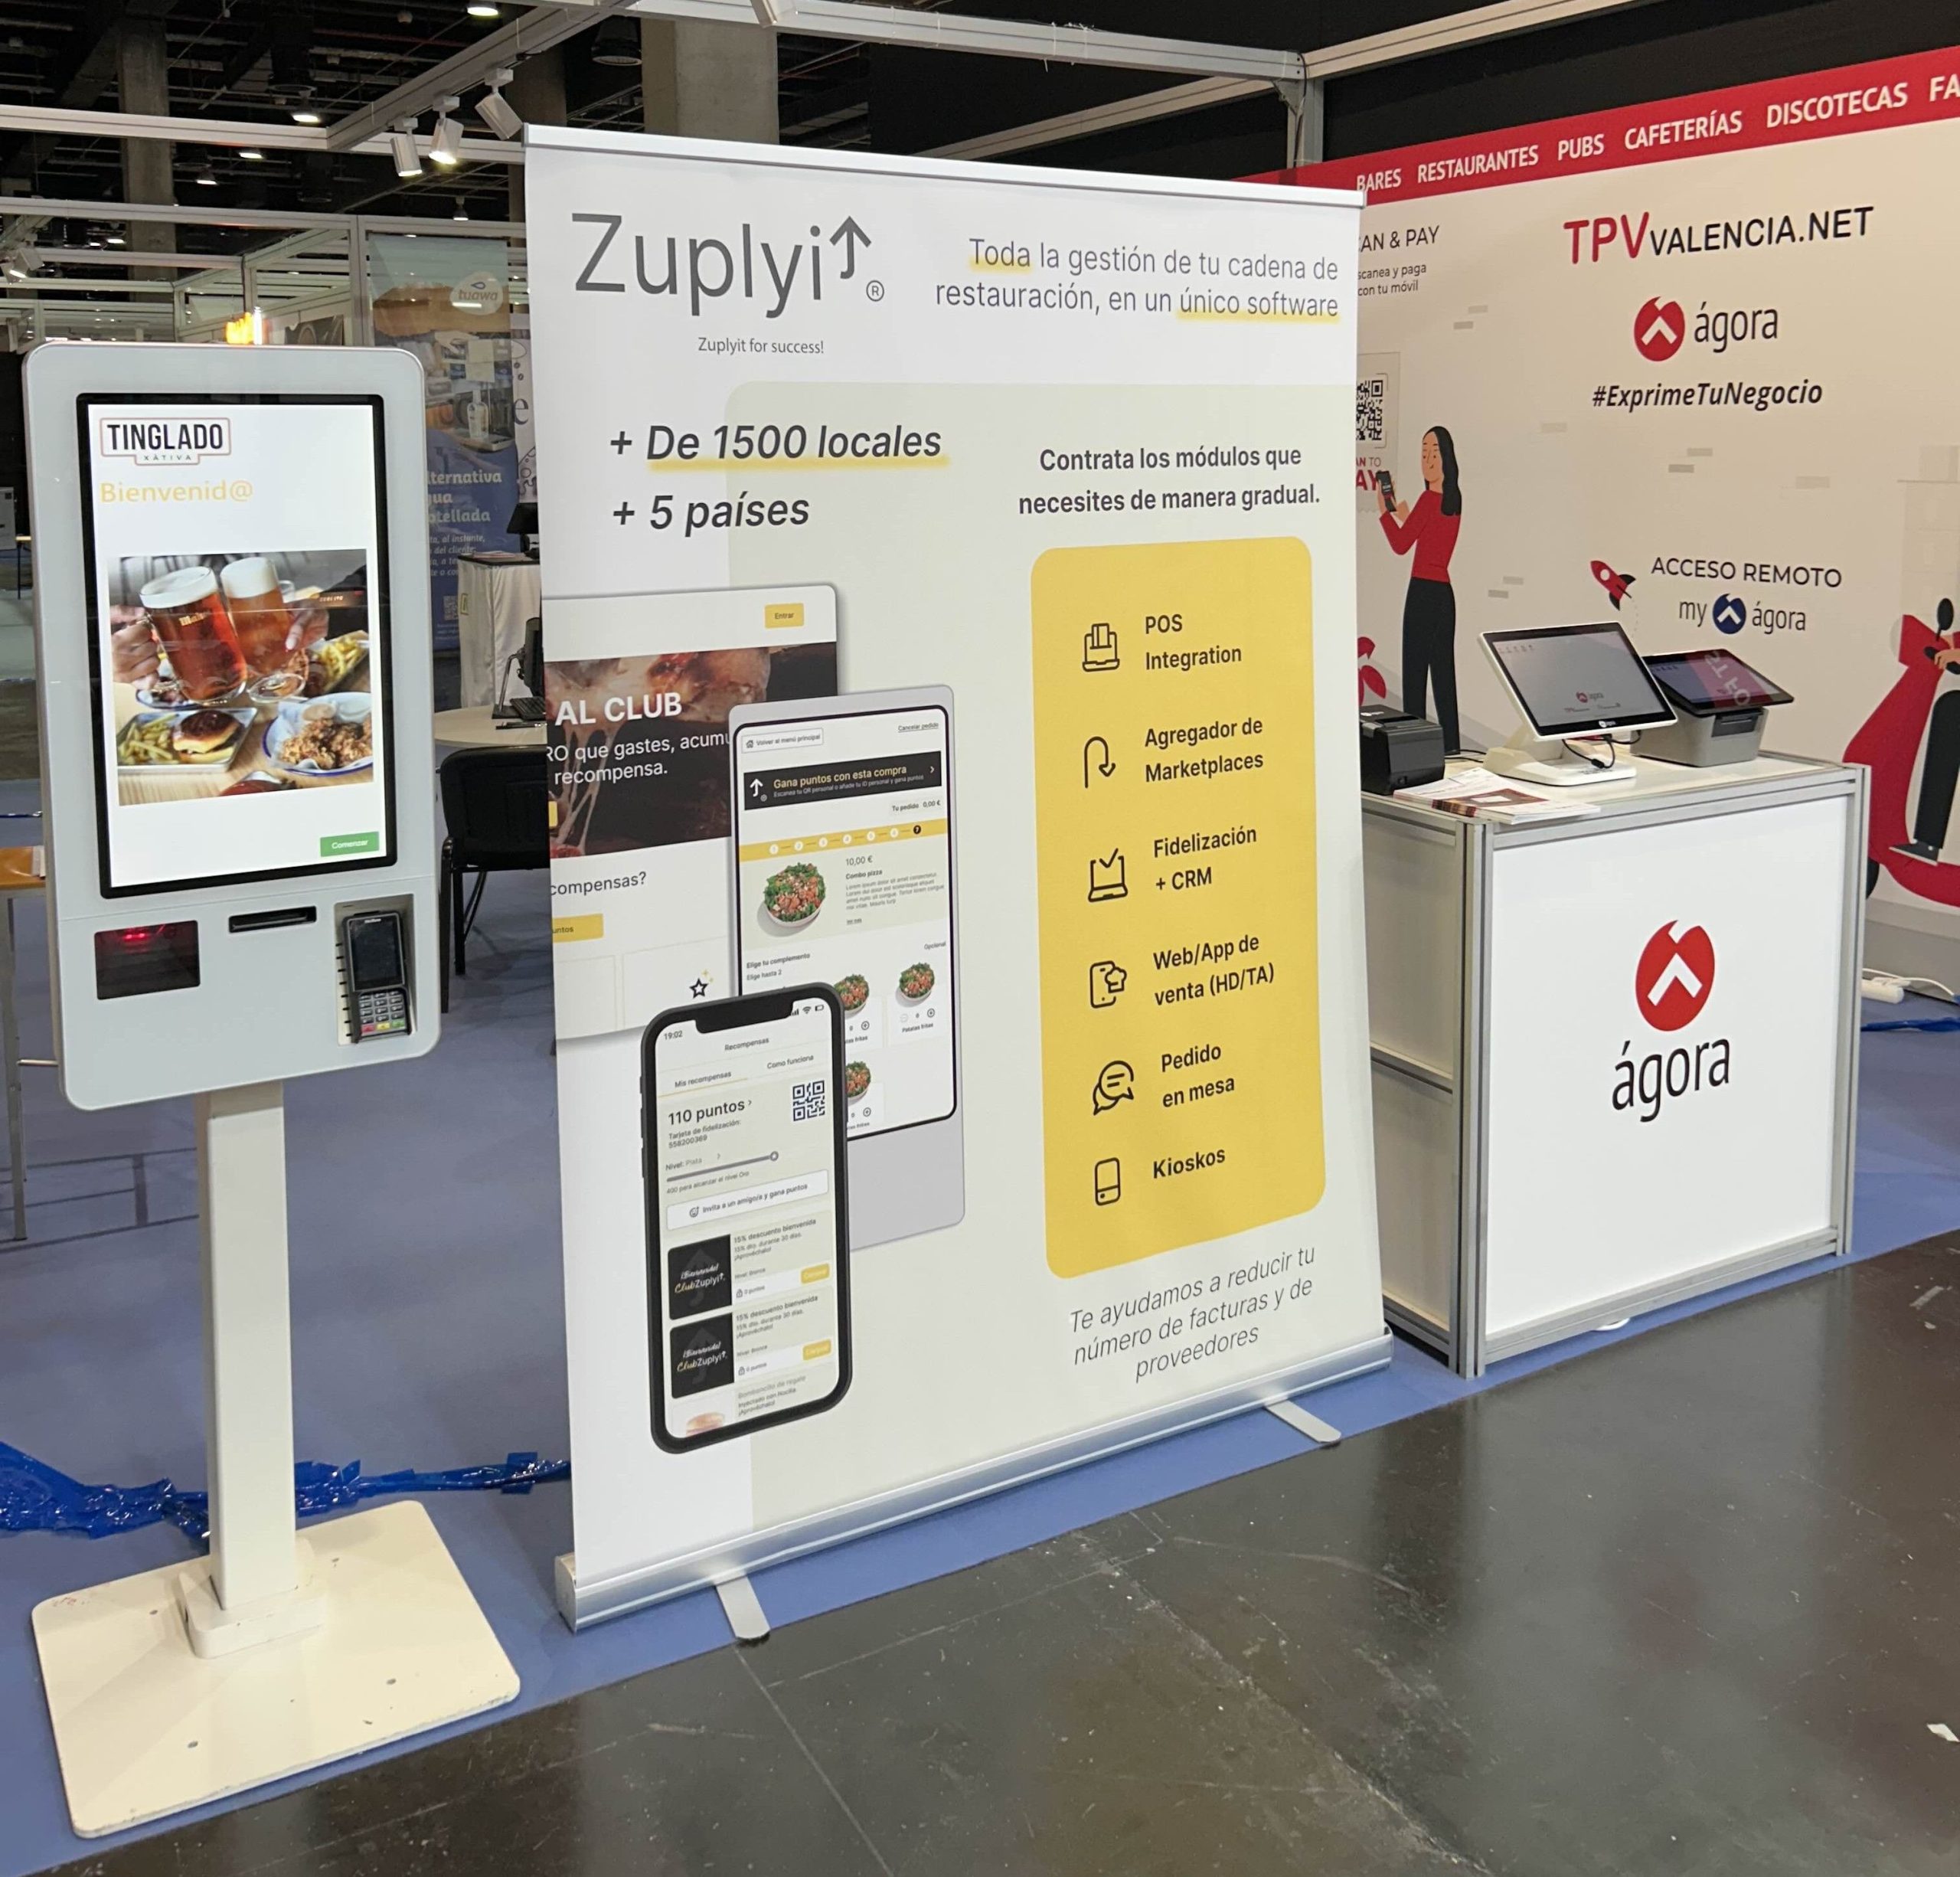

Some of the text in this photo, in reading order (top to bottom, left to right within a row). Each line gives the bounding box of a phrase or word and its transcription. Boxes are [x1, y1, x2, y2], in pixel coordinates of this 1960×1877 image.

[1357, 168, 1402, 191] BARES
[1417, 146, 1539, 184] RESTAURANTES
[1557, 133, 1605, 161] PUBS
[1624, 110, 1743, 149] CAFETERÍAS
[1766, 82, 1908, 129] DISCOTECAS
[1359, 225, 1439, 253] AN & PAY
[969, 238, 1339, 281] Toda la gestión de tu cadena de
[1392, 268, 1399, 279] y
[1401, 263, 1427, 276] paga
[459, 288, 498, 302] tuawa
[936, 280, 1339, 317] restauración, en un único software
[1357, 280, 1419, 296] con tu móvil
[1694, 300, 1779, 354] ágora
[697, 336, 825, 355] Zuplyit for success!
[1592, 378, 1823, 414] #ExprimeTuNegocio
[107, 423, 224, 450] TINGLADO
[610, 424, 942, 461] + De 1500 locales
[1040, 445, 1302, 472] Contrata los módulos que
[1369, 457, 1381, 467] TO
[100, 479, 253, 502] Bienvenid@
[1019, 483, 1321, 514] necesites de manera gradual.
[613, 490, 811, 538] + 5 países
[1651, 556, 1842, 588] ACCESO REMOTO
[1145, 613, 1184, 635] POS
[1679, 600, 1807, 635] my ágora
[1145, 645, 1243, 672] Integration
[554, 692, 683, 726] AL CLUB
[1145, 717, 1263, 750] Agregador de
[575, 744, 609, 762] que
[614, 737, 675, 760] gastes,
[554, 761, 668, 785] recompensa.
[773, 766, 907, 790] Gana puntos con esta compra
[1145, 751, 1264, 783] Marketplaces
[900, 803, 920, 812] pedido
[1153, 826, 1257, 858] Fidelización
[845, 855, 873, 866] 10,00 €
[845, 869, 883, 880] Combo pizza
[1155, 865, 1213, 891] + CRM
[769, 953, 811, 965] complemento
[923, 941, 946, 950] Opcional
[1153, 934, 1259, 971] Web/App de
[1154, 962, 1275, 1006] venta (HD/TA)
[664, 1030, 683, 1040] 19:02
[724, 1037, 769, 1051] Recompensas
[767, 1054, 815, 1070] Como funciona
[1161, 1043, 1222, 1073] Pedido
[675, 1071, 732, 1088] Mis recompensas
[1162, 1077, 1236, 1108] en mesa
[1612, 1038, 1731, 1123] ágora
[668, 1100, 746, 1126] 110 puntos
[1152, 1146, 1226, 1179] Kioskos
[1070, 1247, 1315, 1333] Te ayudamos a reducir tu
[1073, 1277, 1314, 1366] número de facturas y de
[1135, 1326, 1260, 1384] proveedores
